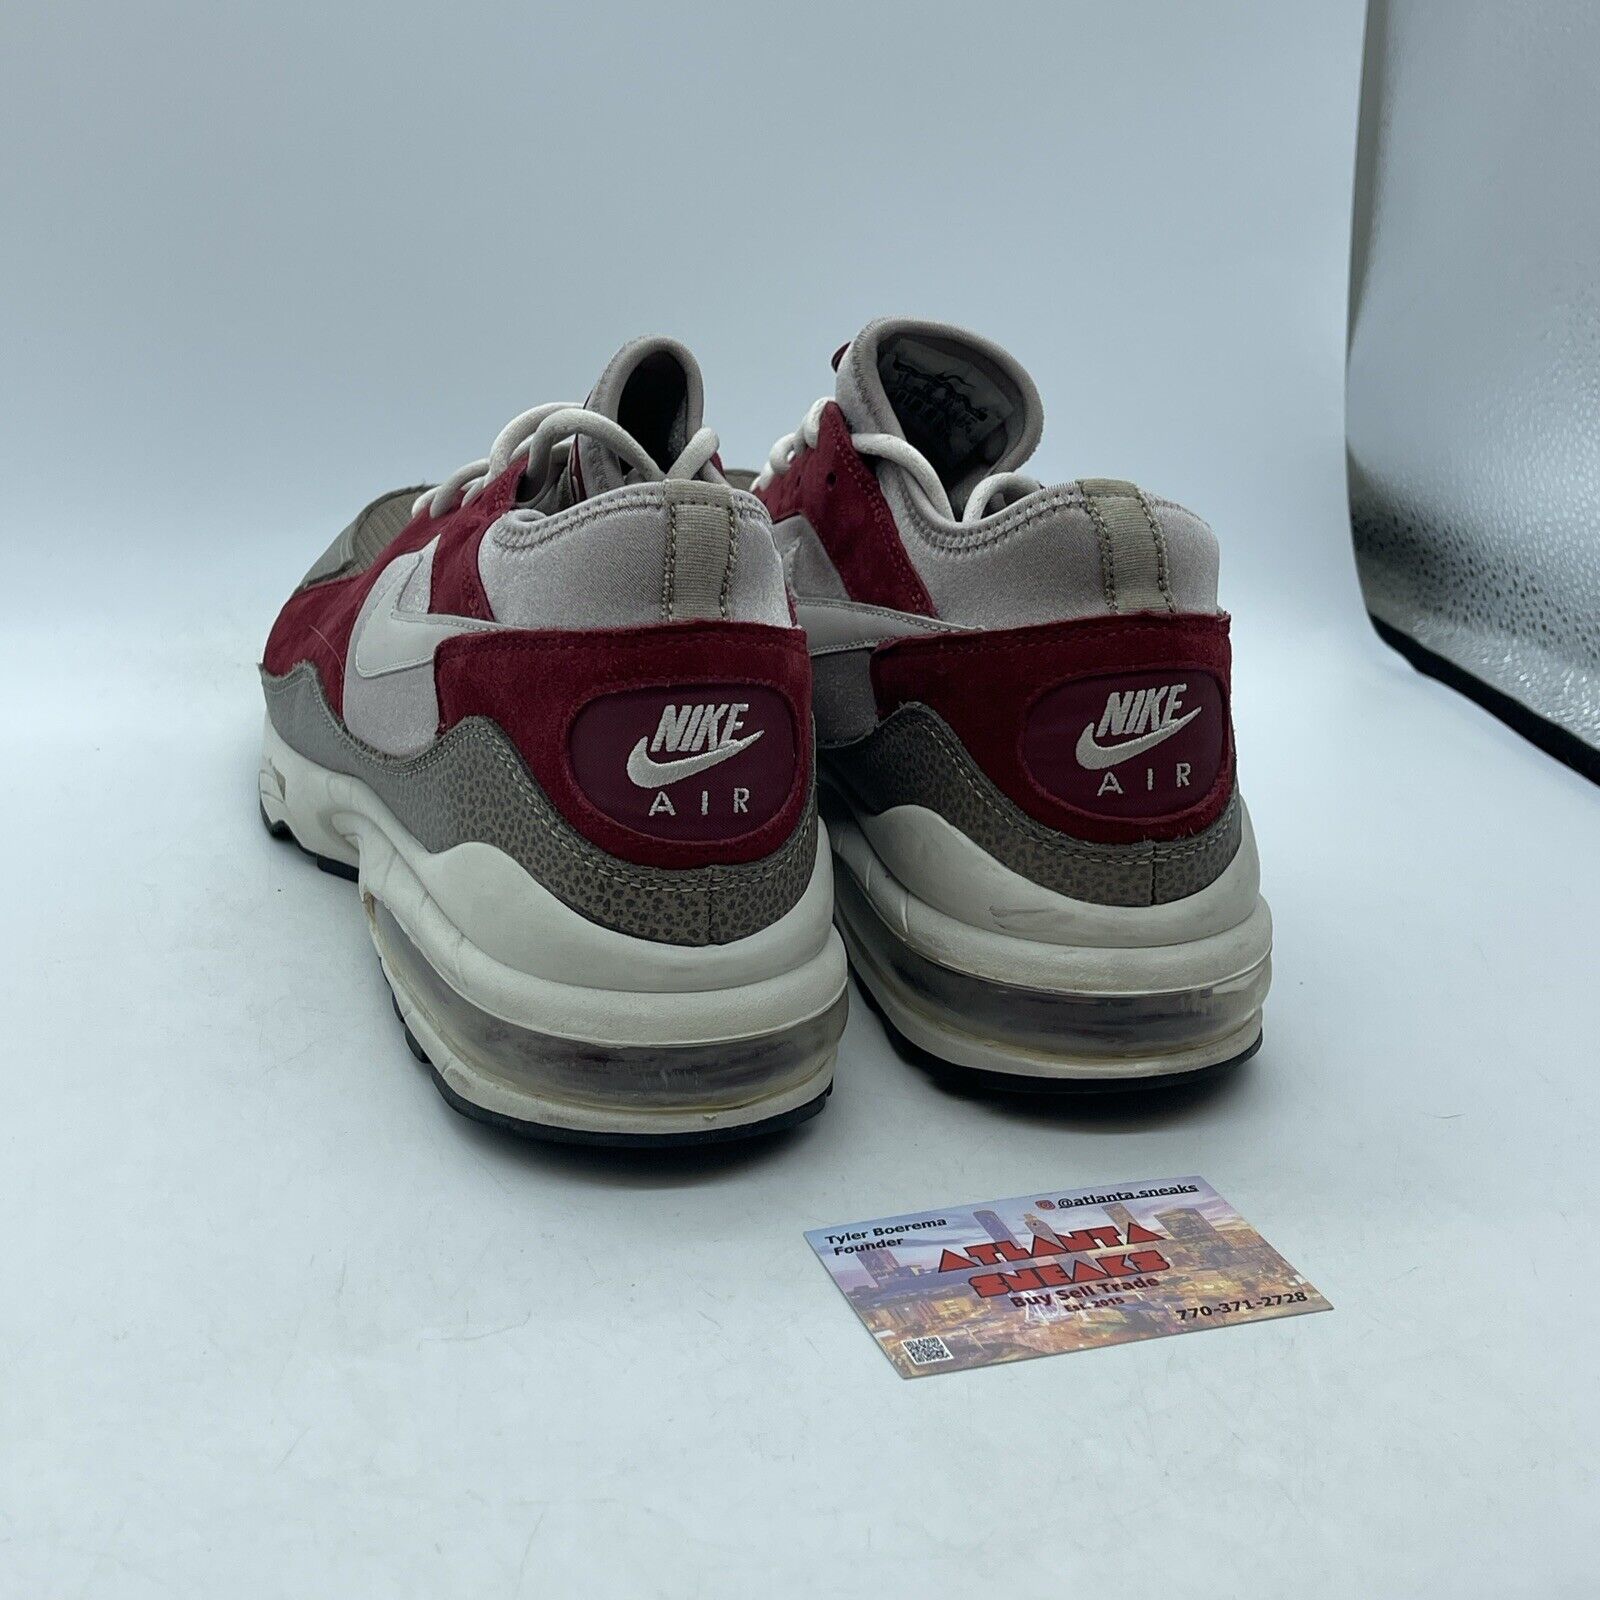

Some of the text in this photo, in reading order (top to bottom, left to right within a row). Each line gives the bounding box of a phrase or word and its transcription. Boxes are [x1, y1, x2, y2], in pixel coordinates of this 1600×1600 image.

[1095, 683, 1188, 738] NIKE
[650, 703, 750, 752] NIKE
[1096, 762, 1192, 797] AIR
[648, 787, 750, 816] AIR
[1057, 1183, 1199, 1210] @atlanta.sneaks
[824, 1217, 948, 1246] Tyler Boerema
[833, 1237, 905, 1257] Founder
[937, 1221, 1168, 1274] ATLANTA
[967, 1249, 1171, 1299] SNEAKS
[1010, 1276, 1161, 1308] Buy Sell Trade
[1062, 1296, 1126, 1313] Est. 2015
[1175, 1291, 1309, 1321] 770-371-2728
